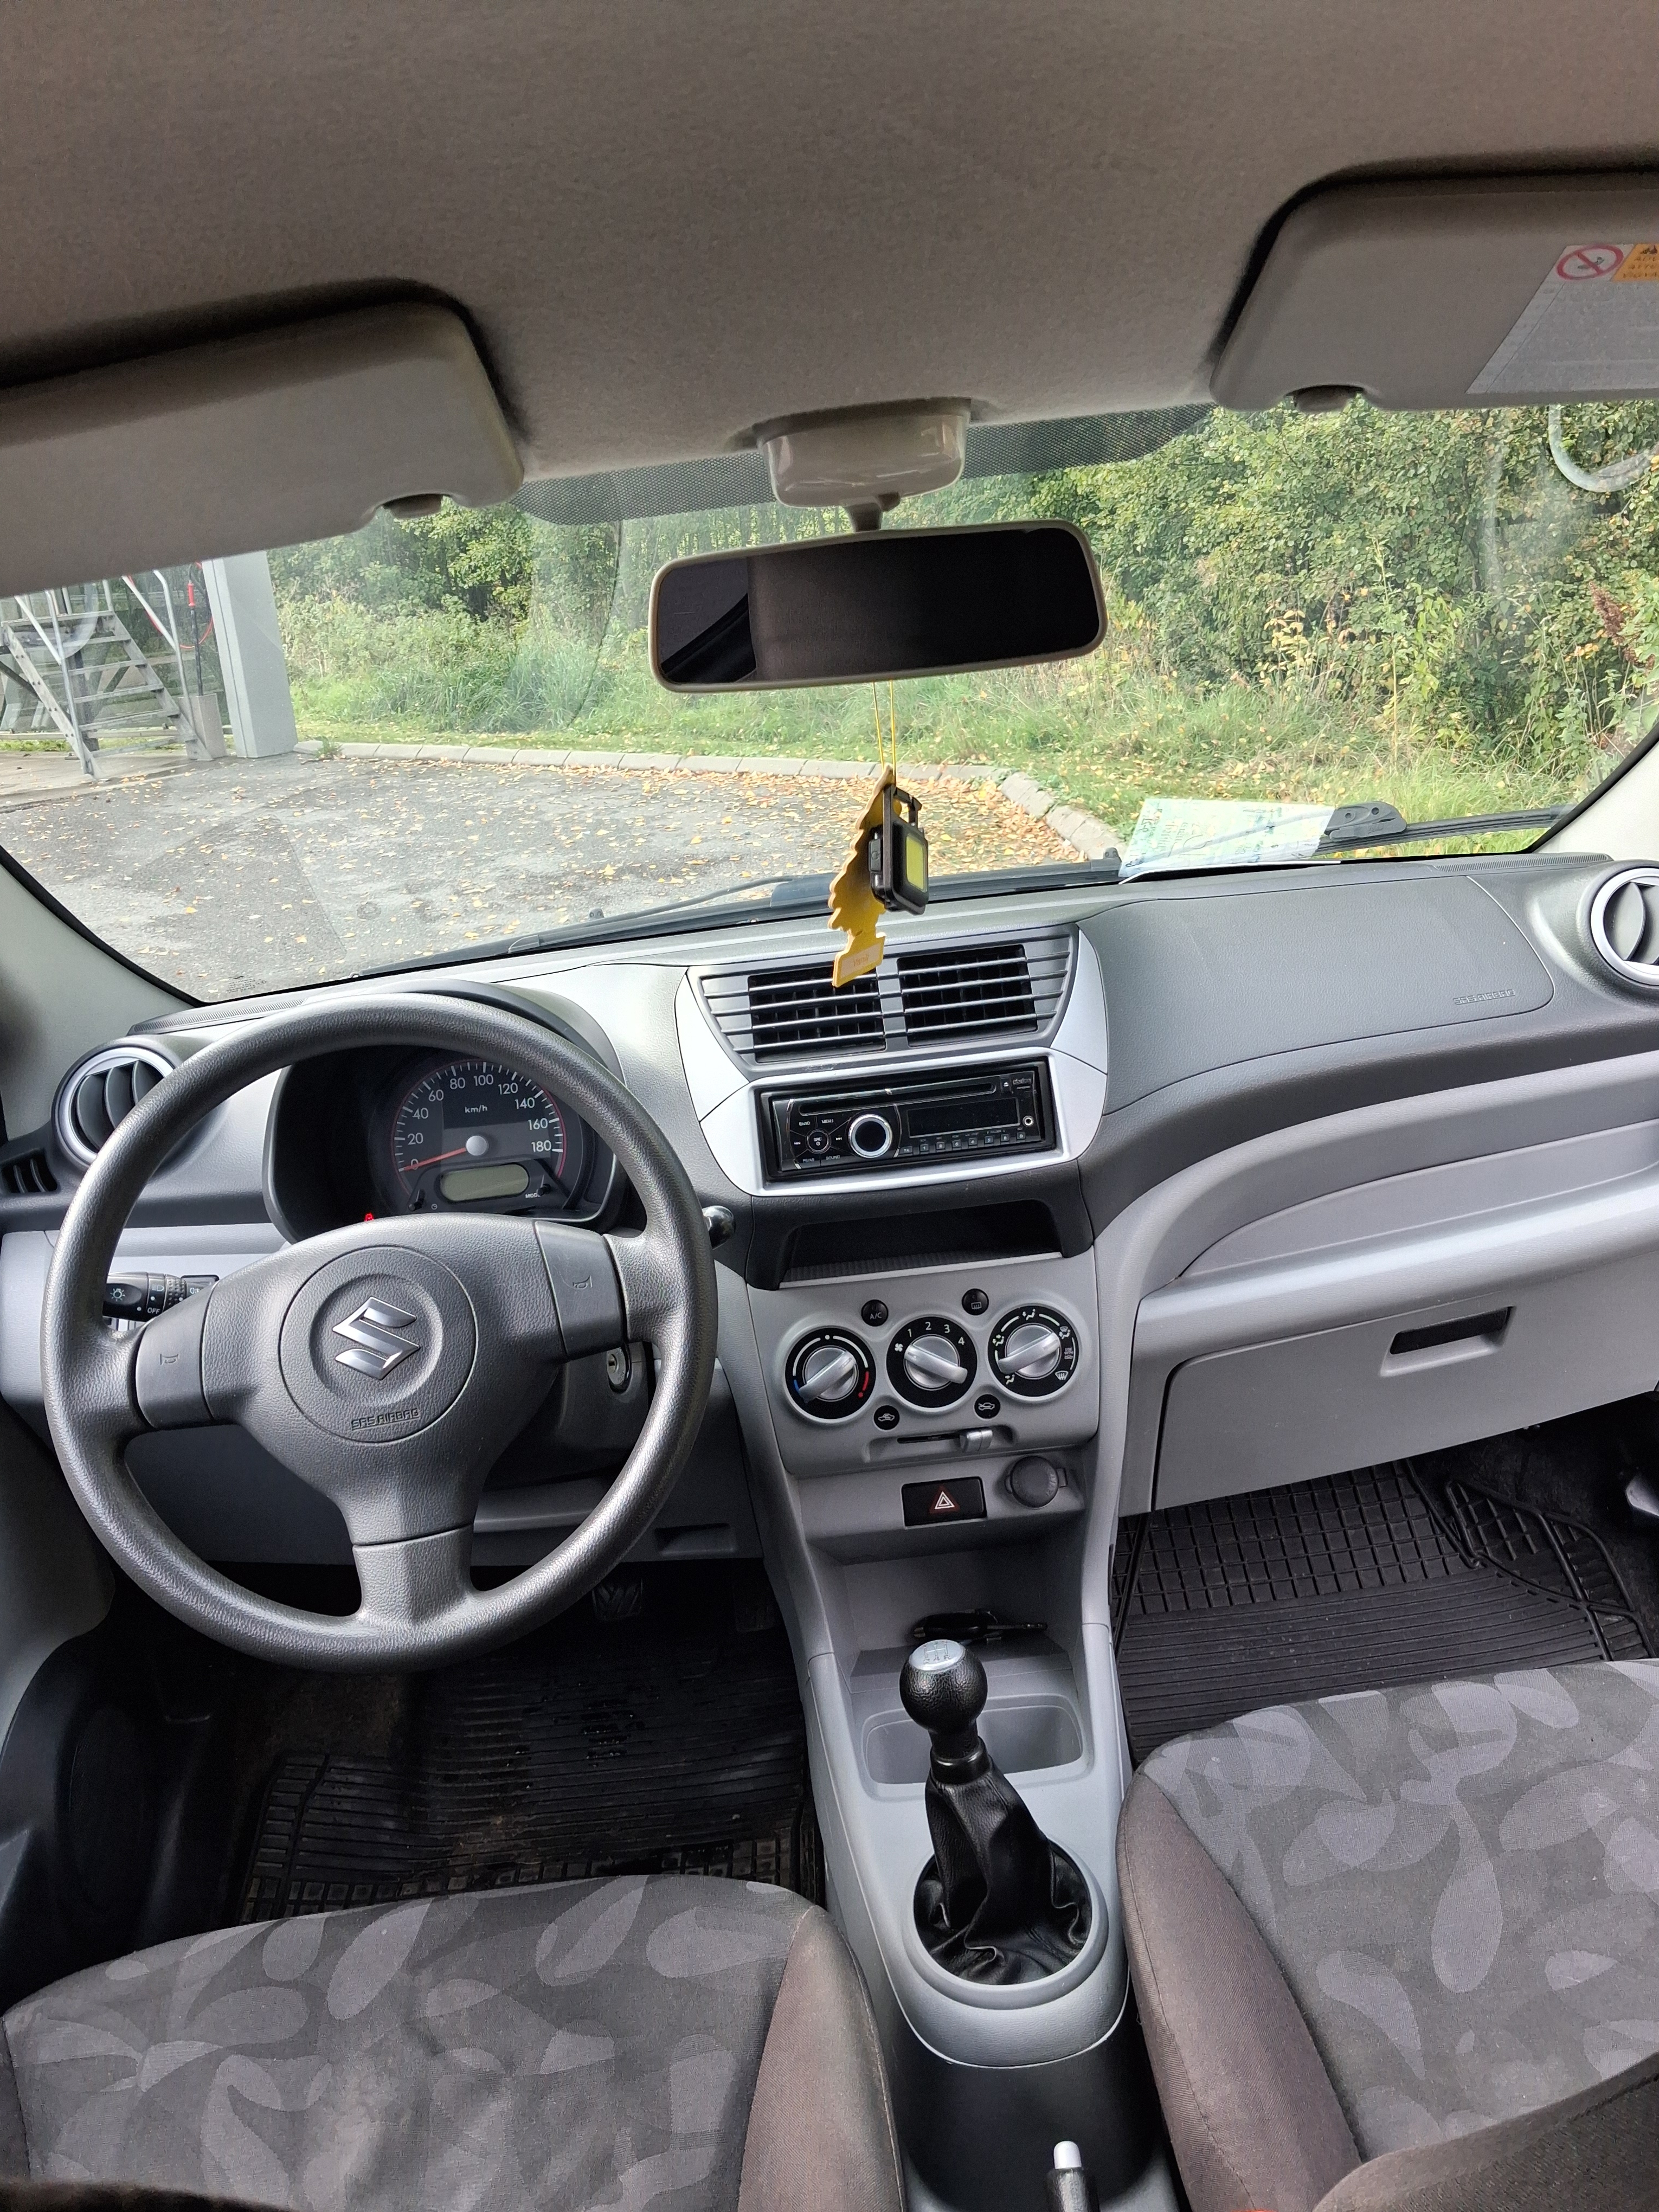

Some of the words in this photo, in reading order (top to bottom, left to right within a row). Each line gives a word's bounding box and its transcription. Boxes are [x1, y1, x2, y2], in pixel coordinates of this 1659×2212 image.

[1477, 989, 1515, 1001] AIRBAG
[449, 1077, 466, 1090] 80
[474, 1075, 493, 1086] 100
[498, 1083, 518, 1095] 120
[428, 1089, 444, 1102] 60
[465, 1104, 487, 1113] km/h
[515, 1097, 535, 1109] 140
[412, 1108, 429, 1119] 40
[528, 1118, 548, 1130] 160
[408, 1133, 423, 1144] 20
[531, 1140, 551, 1152] 180
[410, 1159, 419, 1170] 0
[870, 1312, 882, 1320] A/C
[925, 1322, 931, 1330] 2
[944, 1324, 950, 1333] 3
[908, 1329, 912, 1338] 1
[958, 1336, 964, 1345] 4
[377, 1408, 420, 1425] AIRBAG
